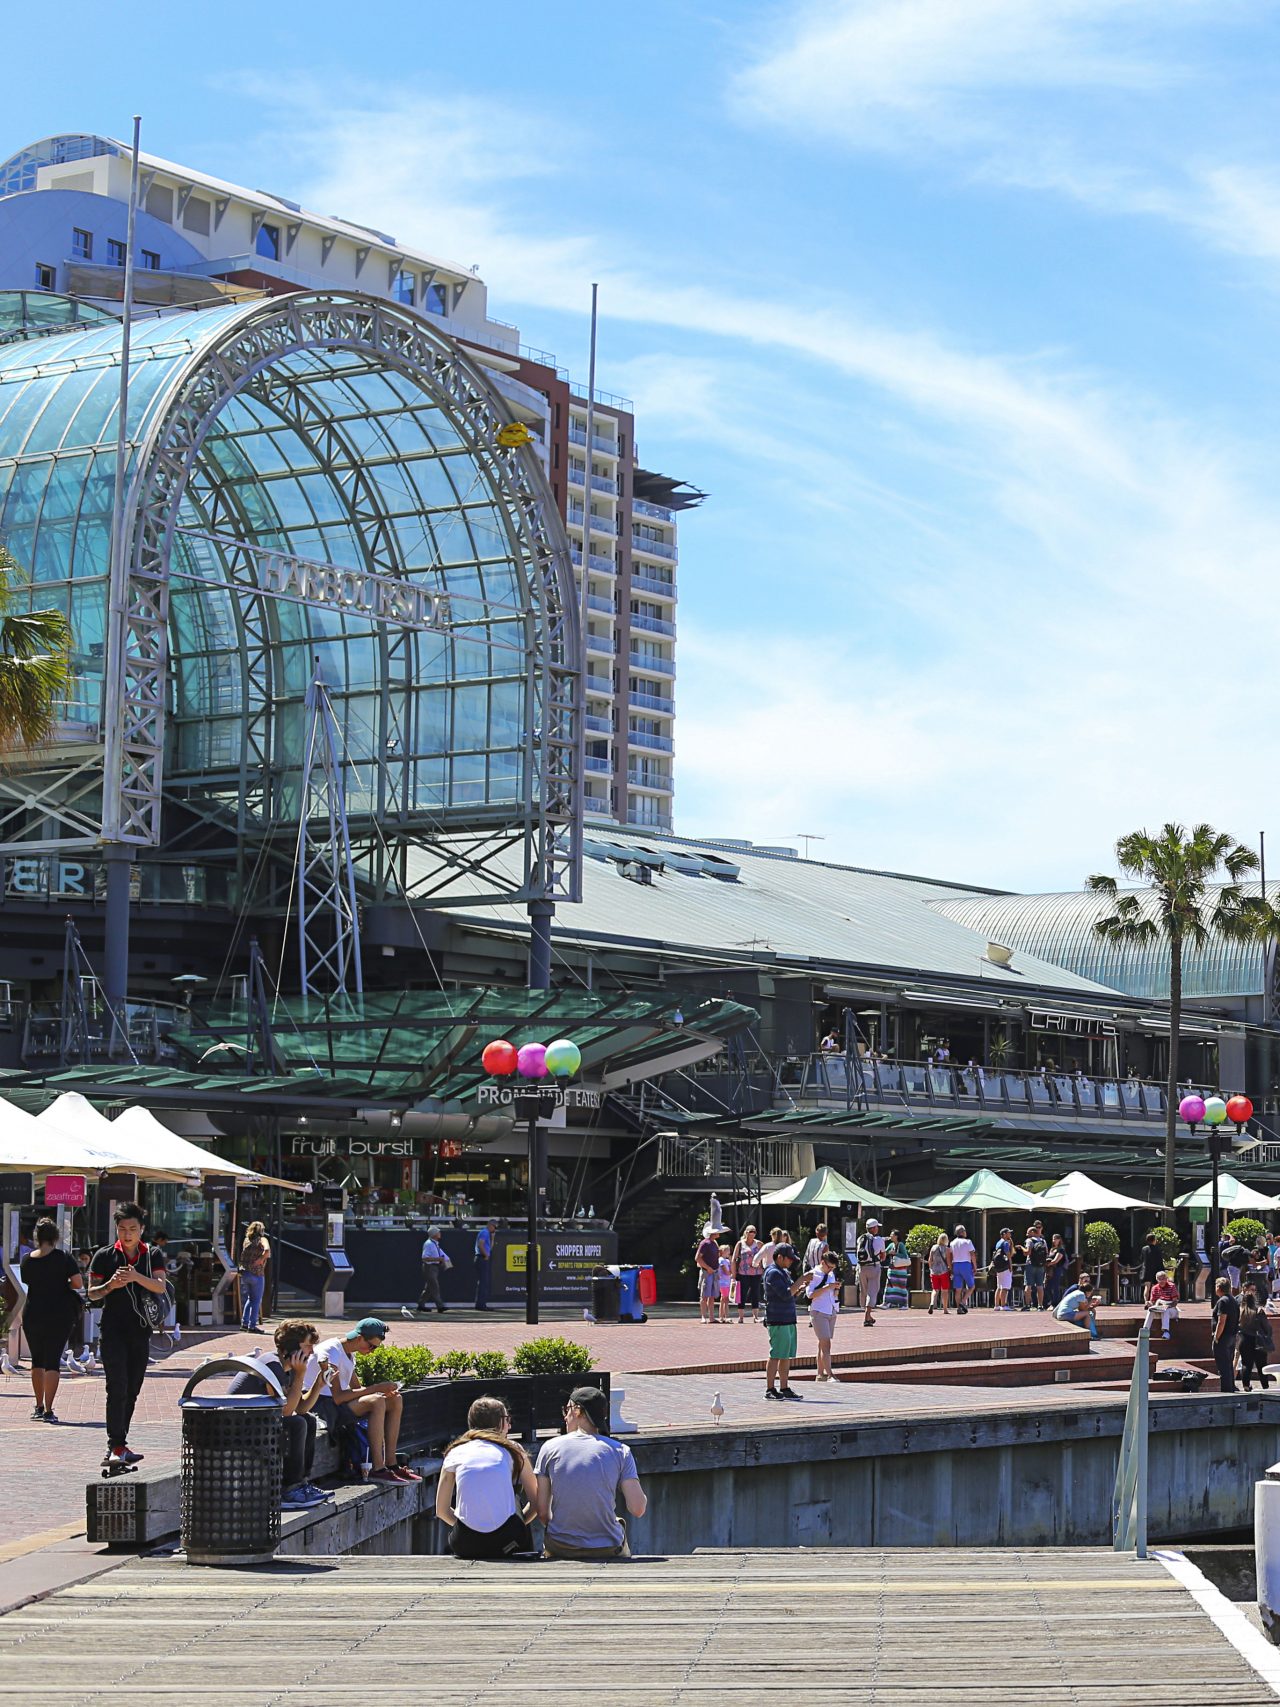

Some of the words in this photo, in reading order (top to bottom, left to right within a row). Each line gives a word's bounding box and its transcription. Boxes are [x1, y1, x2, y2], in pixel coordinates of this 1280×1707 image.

[256, 555, 452, 629] HARBOURSIDE
[292, 1137, 336, 1154] fruit
[350, 1137, 413, 1155] burst!
[46, 1191, 83, 1201] zaaffran
[555, 1244, 583, 1257] SHOPPER
[584, 1244, 602, 1257] HOPPER
